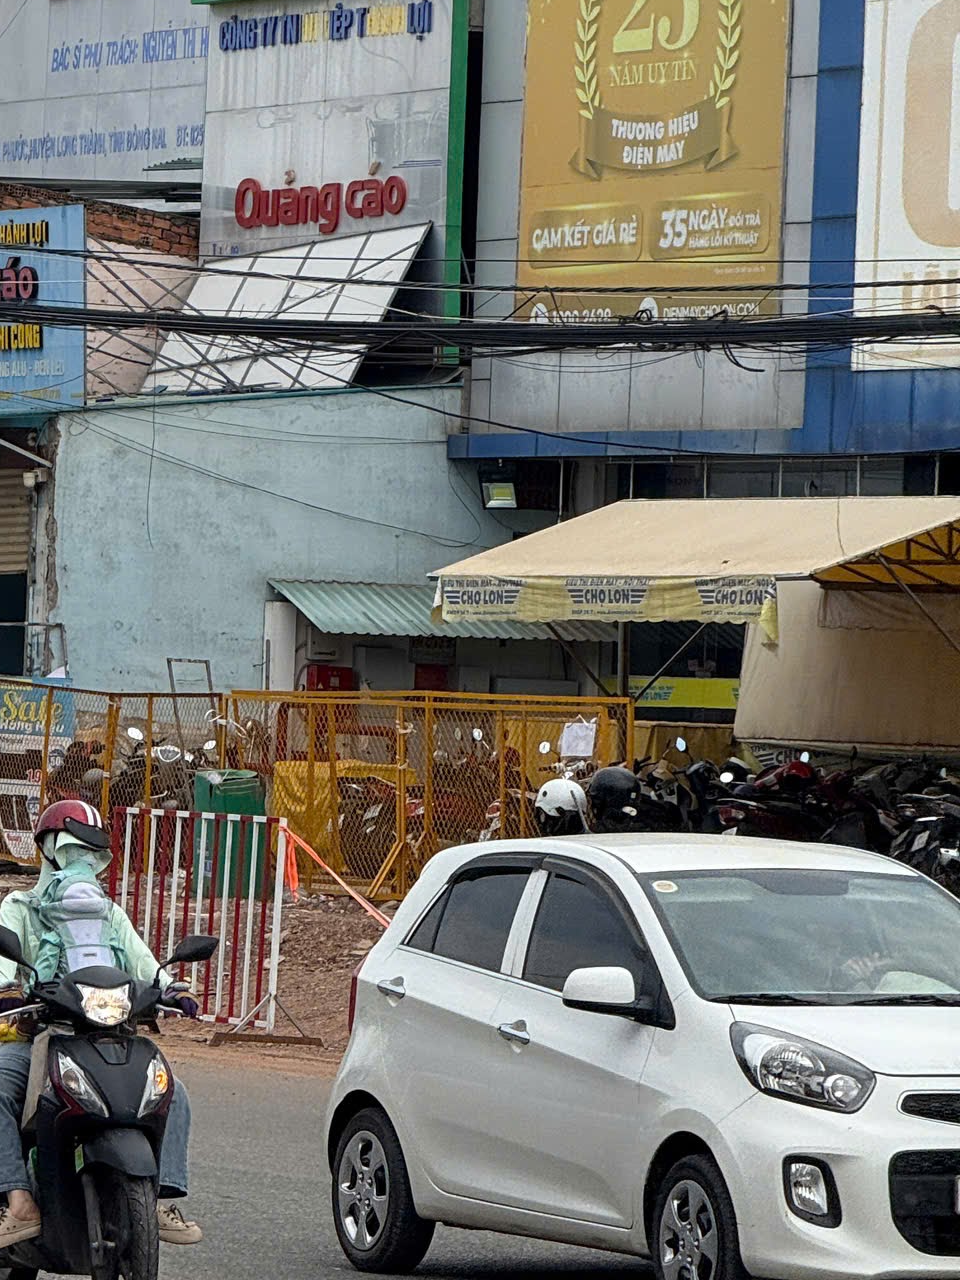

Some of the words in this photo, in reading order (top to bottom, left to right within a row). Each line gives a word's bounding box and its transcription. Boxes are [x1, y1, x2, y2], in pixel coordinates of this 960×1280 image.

[219, 14, 259, 52] CÔNG
[258, 15, 280, 47] TY
[406, 0, 434, 42] LỢI
[51, 41, 71, 72] BÁC
[83, 41, 104, 74] PHỤ
[647, 60, 669, 85] UY
[671, 51, 697, 81] TÍN
[667, 110, 699, 137] HIỆU
[56, 134, 78, 157] LONG
[622, 142, 654, 169] ĐIỆN
[655, 138, 685, 164] MÁY
[235, 169, 343, 235] Quảng
[344, 161, 409, 219] cáo
[28, 220, 50, 248] LỢI
[532, 226, 563, 252] CAM
[562, 218, 591, 248] KẾT
[592, 218, 617, 245] GIÁ
[619, 214, 638, 244] RẺ
[658, 209, 689, 249] 35
[688, 203, 729, 232] NGÀY
[688, 235, 711, 249] HÀNG
[735, 232, 759, 247] THUẬT
[11, 359, 28, 377] ALU
